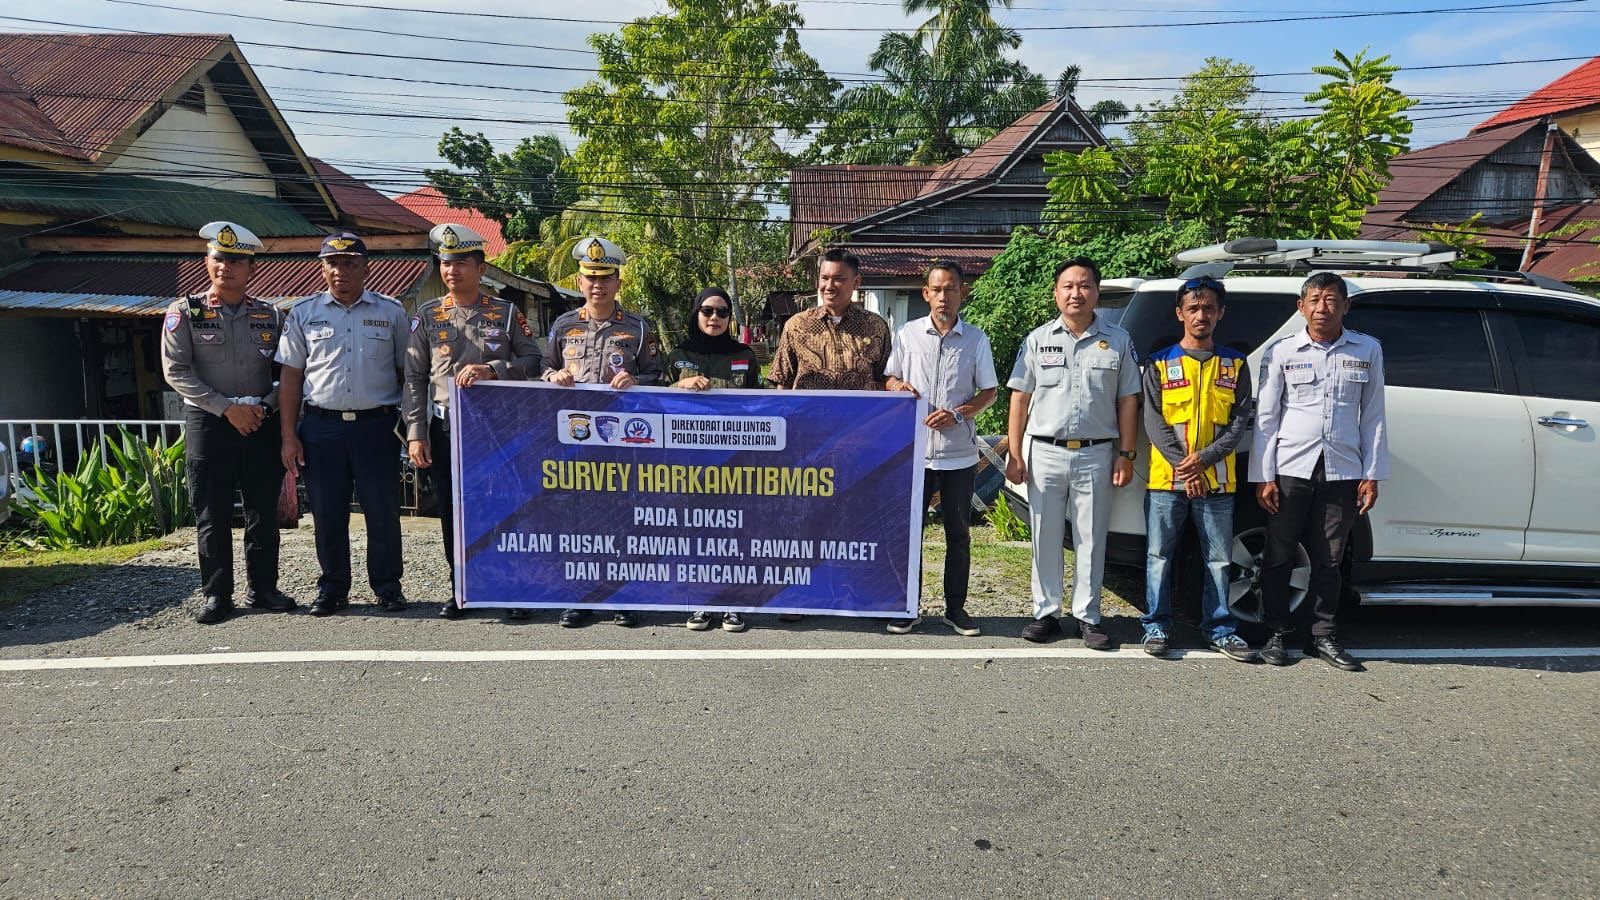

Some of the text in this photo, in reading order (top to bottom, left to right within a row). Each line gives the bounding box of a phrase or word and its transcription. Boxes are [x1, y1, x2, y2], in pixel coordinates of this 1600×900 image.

[671, 419, 771, 433] DIREKTORAT LALU LINTAS
[671, 432, 698, 444] POLDA
[699, 433, 741, 445] SULAWESI
[741, 434, 777, 446] SELATAN
[542, 460, 834, 497] SURVEY HARKAMTIBMAS
[633, 506, 744, 529] PADA LOKASI
[497, 533, 878, 561] JALAN RUSAK, RAWAN LAKA, RAWAN MACET
[565, 561, 811, 585] DAN RAWAN BENCANA ALAM
